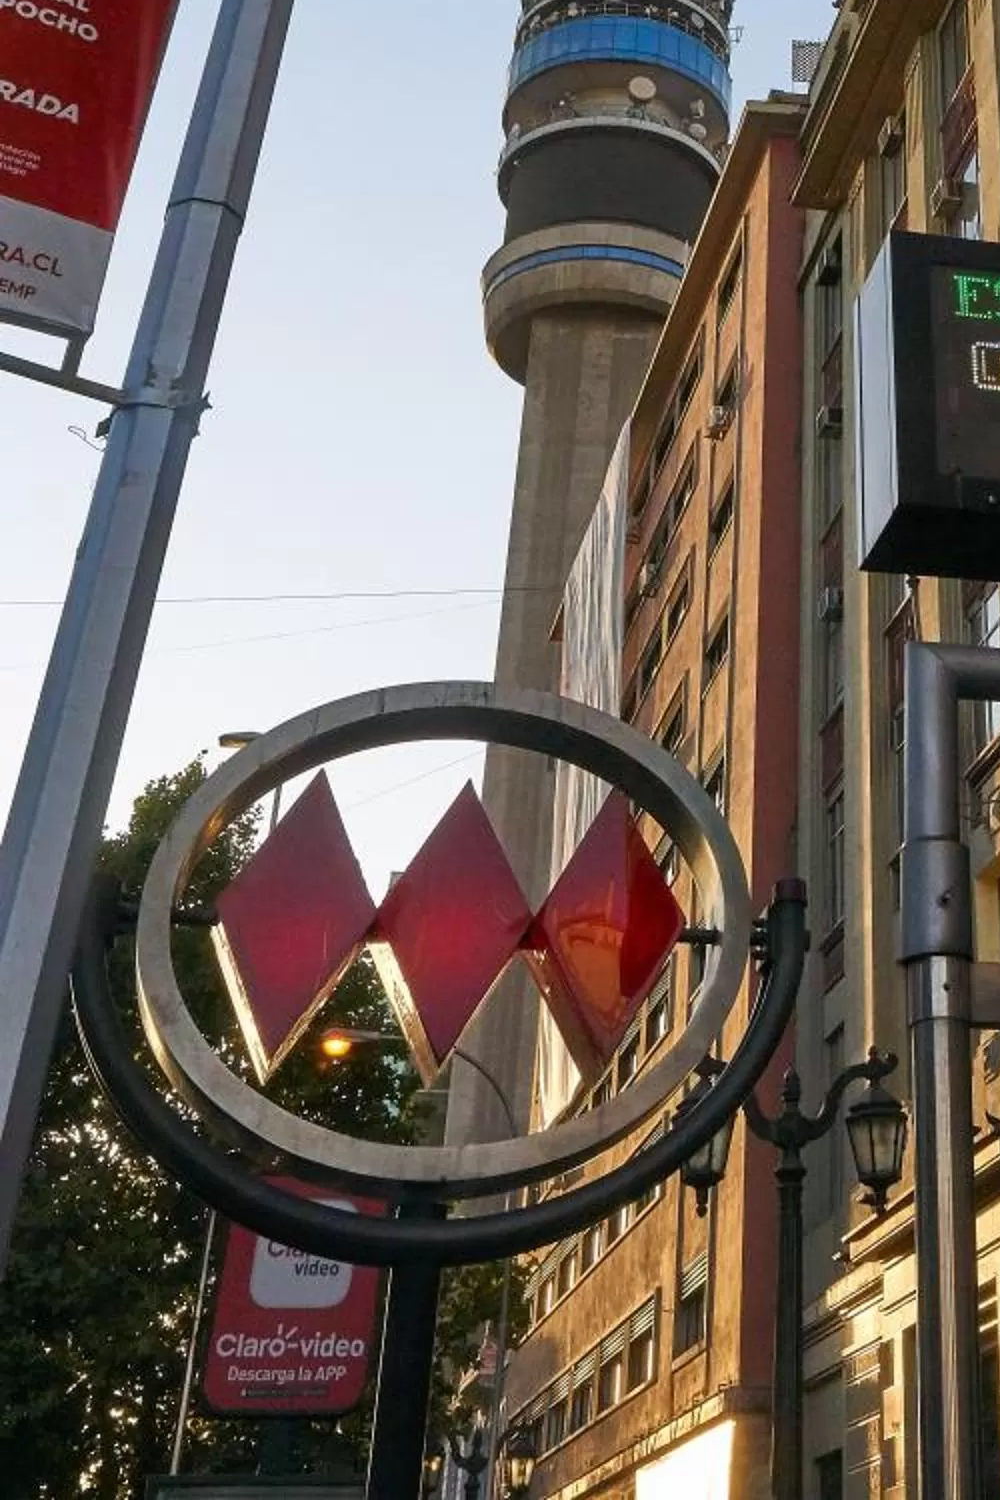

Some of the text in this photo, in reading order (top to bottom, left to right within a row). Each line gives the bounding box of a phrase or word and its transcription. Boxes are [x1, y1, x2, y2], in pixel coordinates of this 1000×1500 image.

[294, 1260, 339, 1277] video
[216, 1332, 365, 1358] Claro video
[227, 1366, 347, 1385] Descarga la APP
